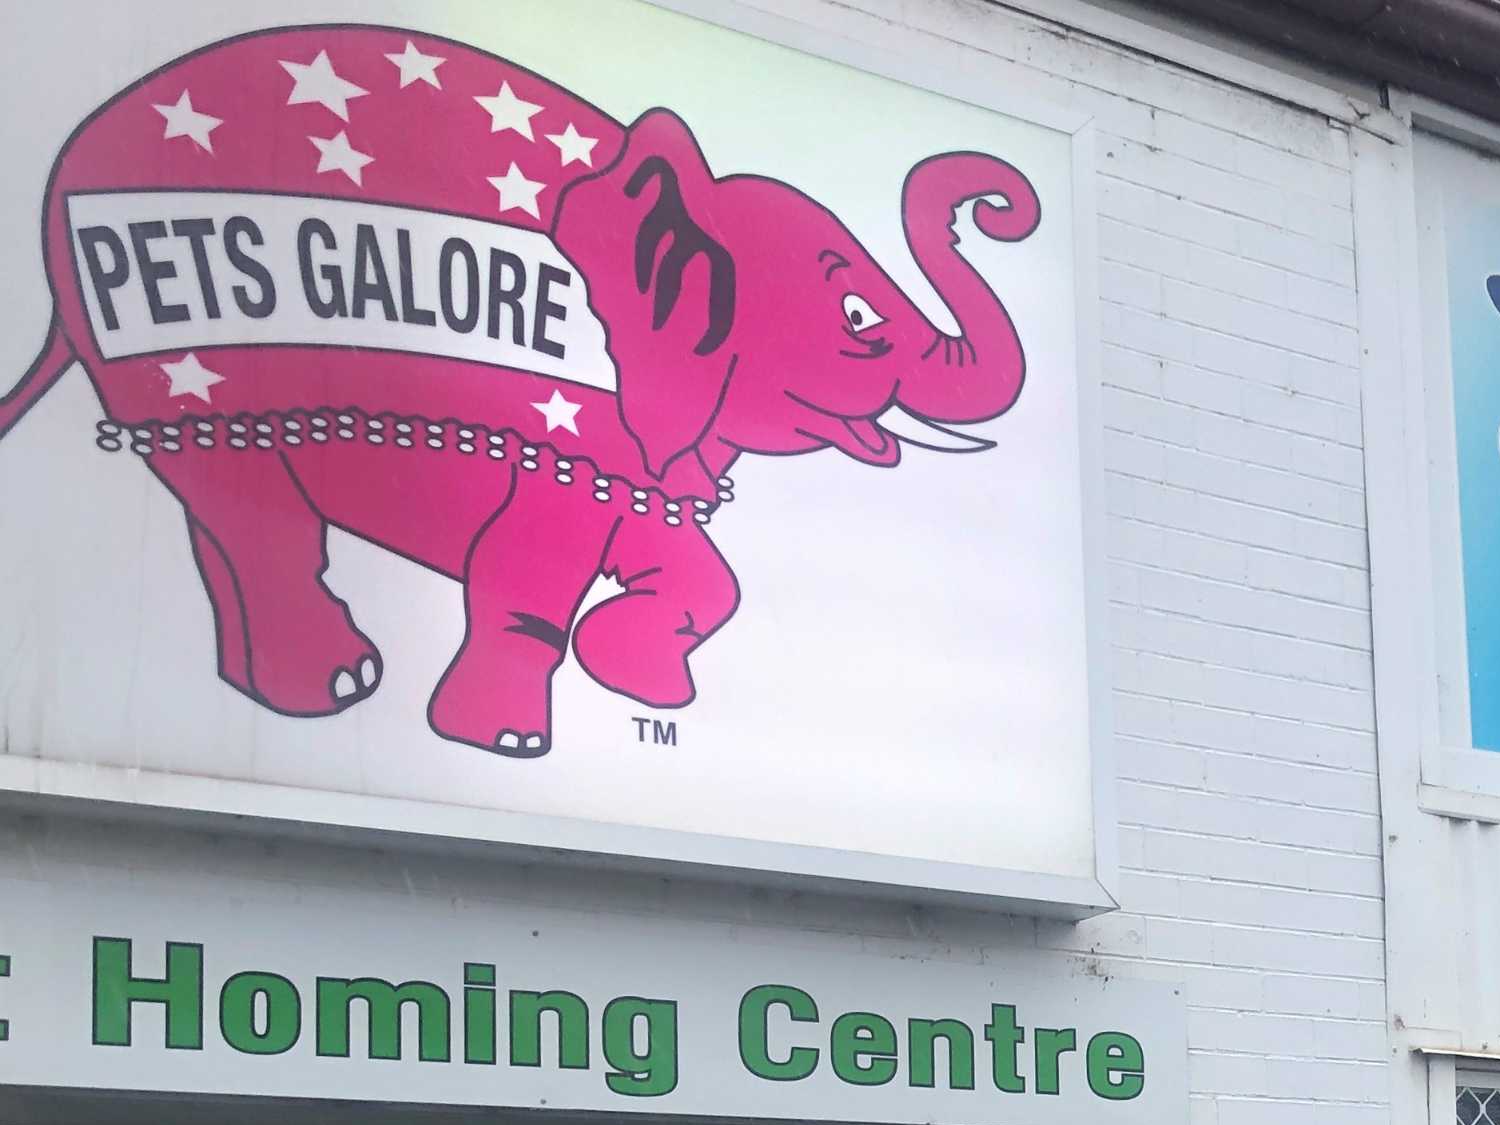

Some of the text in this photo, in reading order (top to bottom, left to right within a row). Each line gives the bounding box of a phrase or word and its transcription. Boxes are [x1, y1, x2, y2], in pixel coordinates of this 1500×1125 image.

[76, 215, 574, 360] PETS GALORE
[631, 717, 678, 747] TM
[91, 936, 679, 1098] Homing
[738, 984, 1145, 1100] Centre
